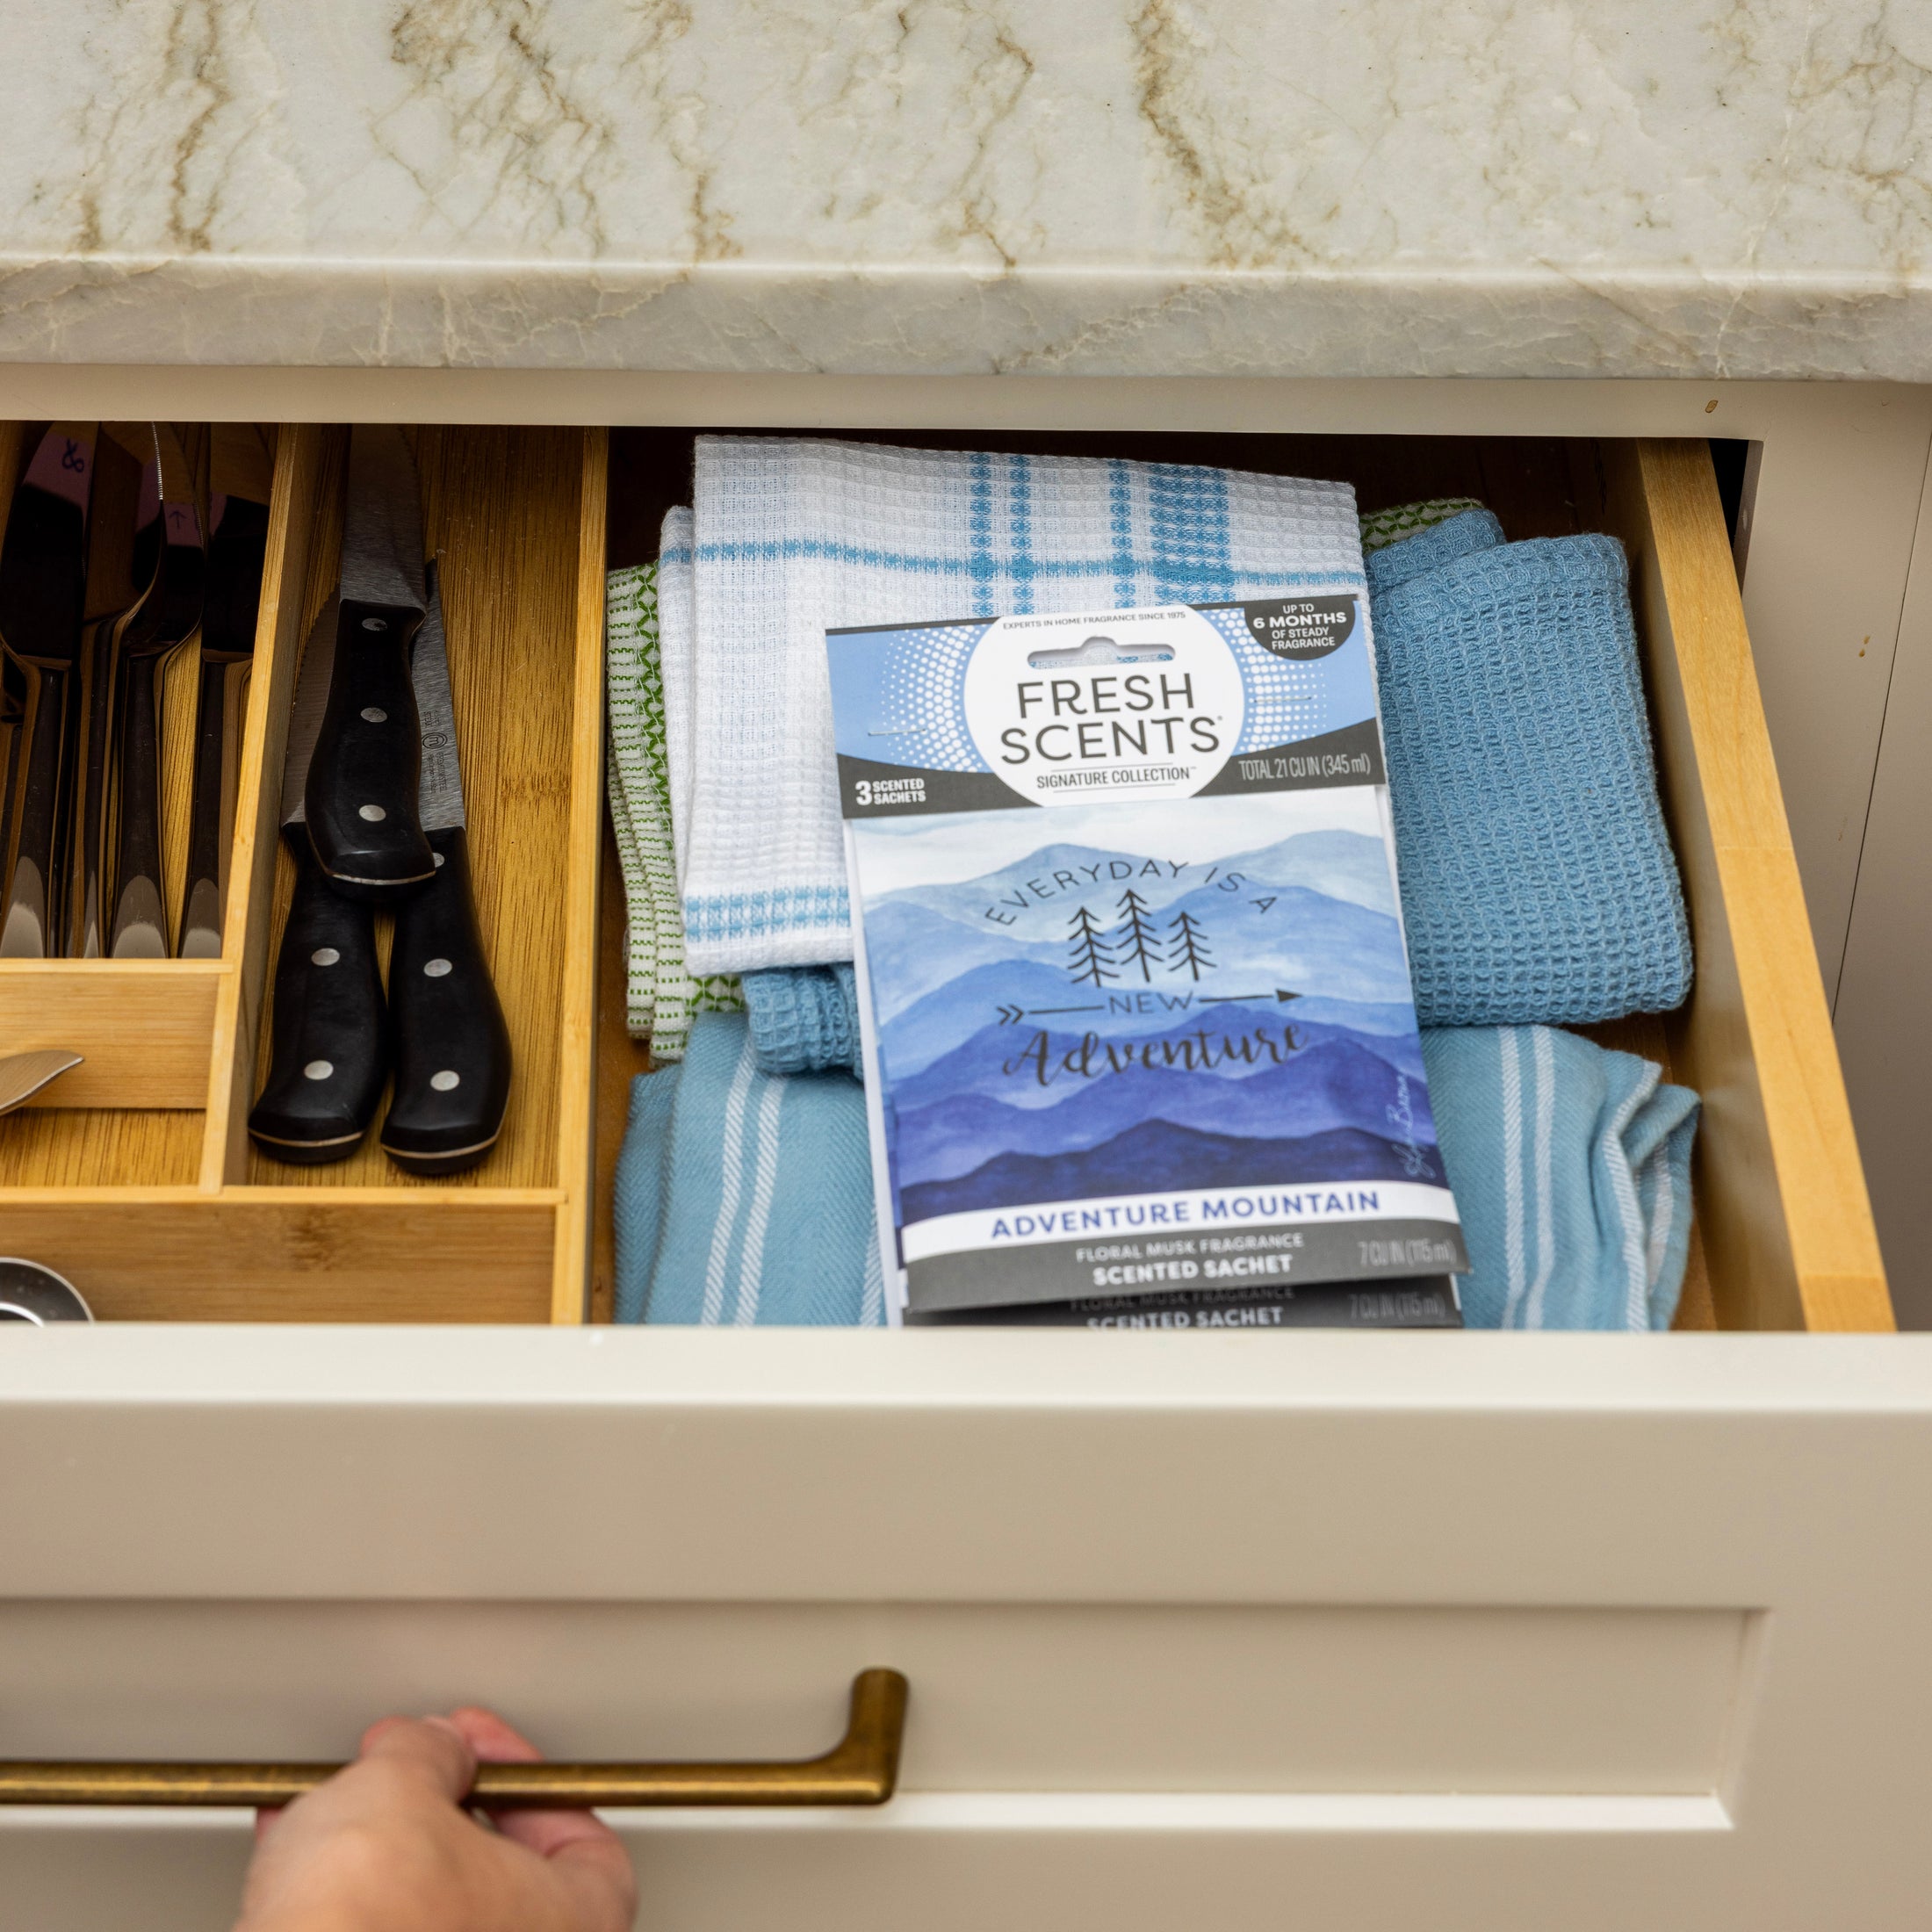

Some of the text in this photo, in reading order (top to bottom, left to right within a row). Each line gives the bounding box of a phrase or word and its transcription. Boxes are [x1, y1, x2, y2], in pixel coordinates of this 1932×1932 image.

[1003, 620, 1042, 630] EXPERTS
[1055, 617, 1082, 626] HOME
[1083, 614, 1136, 624] FRAGRANCE
[1138, 612, 1165, 621] SINCE
[1253, 611, 1347, 629] 6 MONTHS
[1282, 603, 1315, 614] UP TO
[1272, 626, 1330, 639] OF STEADY
[1272, 637, 1336, 650] FRAGRANCE
[1017, 673, 1194, 718] FRESH
[1000, 716, 1220, 765] SCENTS
[1036, 767, 1191, 789] SIGNATURE COLLECTION
[1238, 753, 1372, 781] TOTAL 21 CU IN (345 ml)
[854, 777, 925, 806] 3 SCENTED
[873, 790, 926, 805] SACHETS
[984, 859, 1278, 926] EVERYDAY IS A
[1107, 991, 1193, 1014] NEW
[1002, 1023, 1310, 1087] Adventure
[991, 1191, 1381, 1240] ADVENTURE MOUNTAIN
[1076, 1232, 1305, 1263] FLORAL MUSK FRAGRANCE
[1092, 1254, 1294, 1287] SCENTED SACHET
[1195, 1306, 1284, 1329] SACHET
